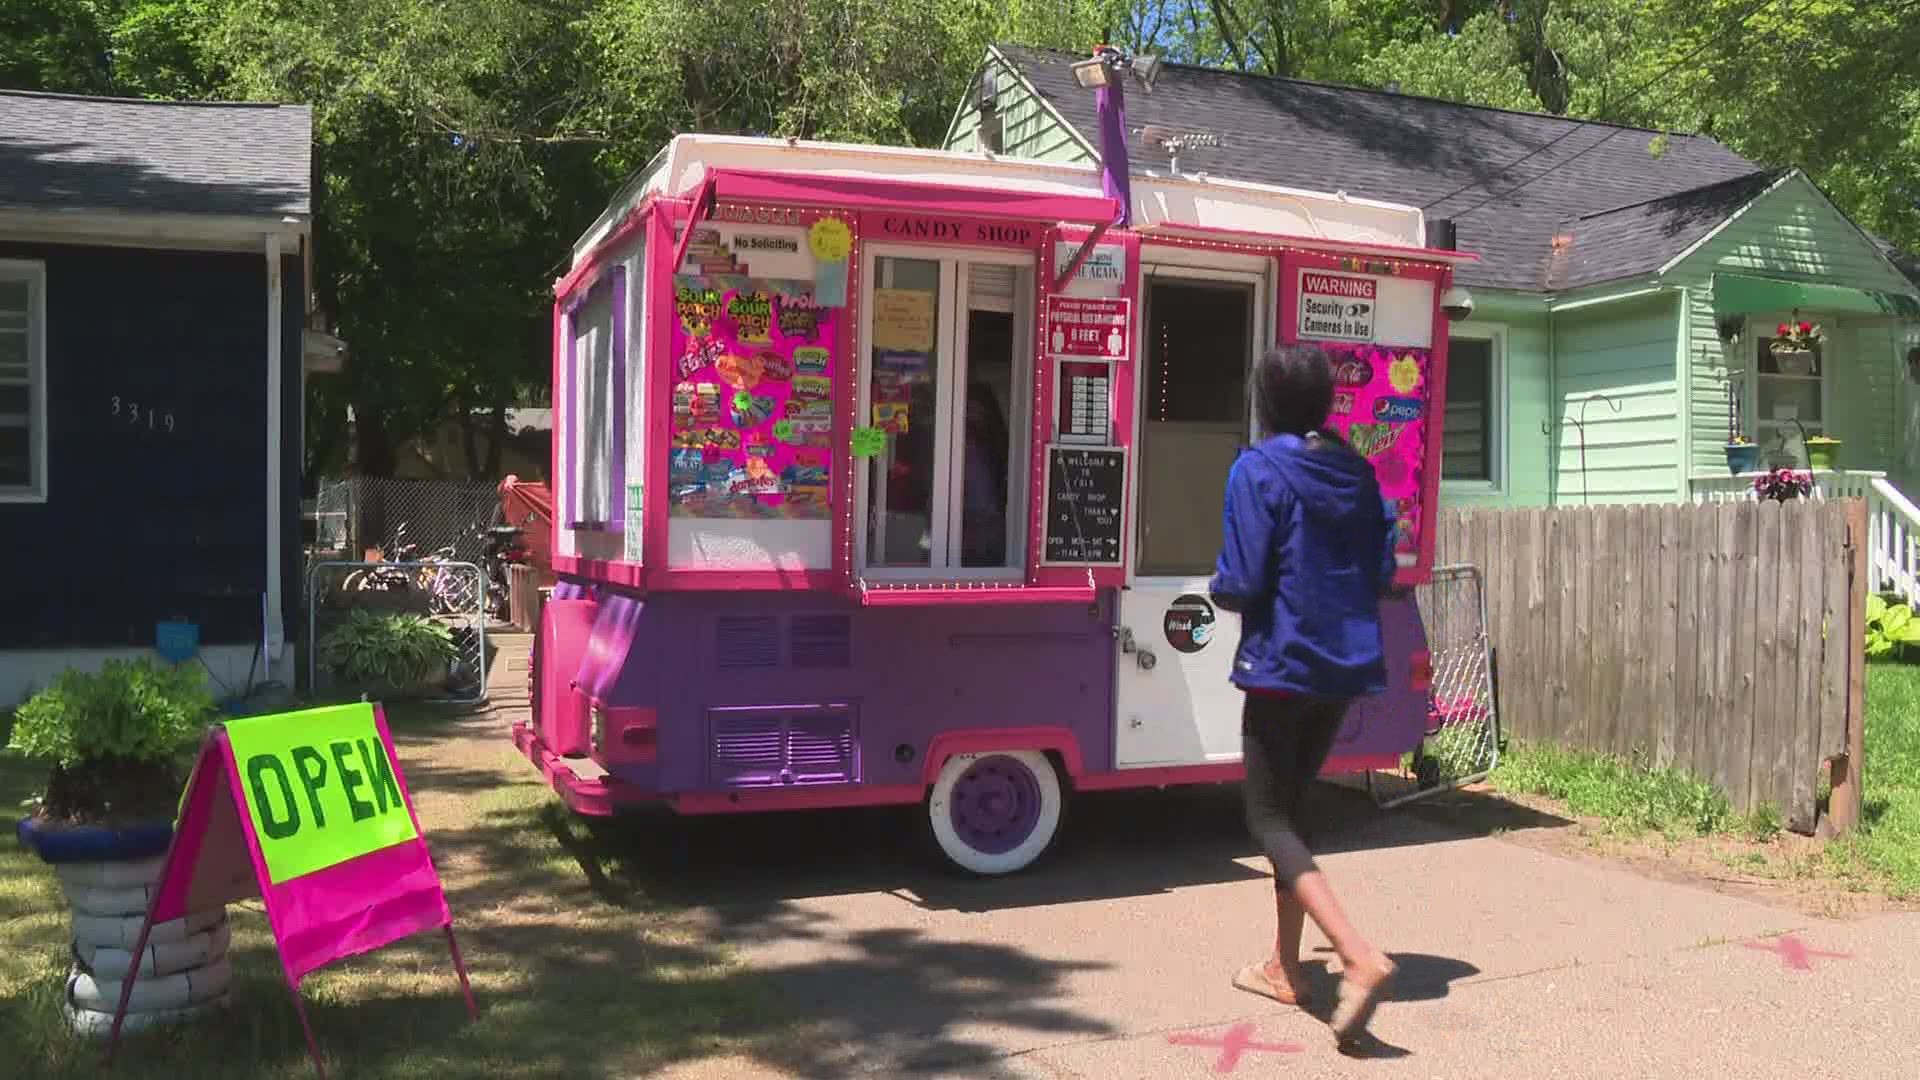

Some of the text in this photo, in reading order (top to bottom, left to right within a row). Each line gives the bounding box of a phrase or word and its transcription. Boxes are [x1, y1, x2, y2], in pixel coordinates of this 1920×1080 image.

[884, 217, 1033, 244] CANDY SHOP
[734, 236, 748, 249] No
[751, 237, 798, 253] Soliciting
[1087, 265, 1118, 280] AGAIN
[1305, 275, 1374, 297] WARNING
[678, 287, 722, 304] SOUR
[677, 302, 722, 321] PATCH
[728, 302, 771, 315] SOUR
[1304, 298, 1344, 319] Security
[1079, 328, 1100, 342] FEET
[1303, 317, 1342, 335] Cameras
[1353, 321, 1369, 337] Use
[111, 395, 175, 433] 3319
[1068, 457, 1105, 467] WELCOME
[1081, 468, 1091, 477] TO
[1047, 536, 1064, 545] OPEN
[246, 735, 404, 841] OPEN
